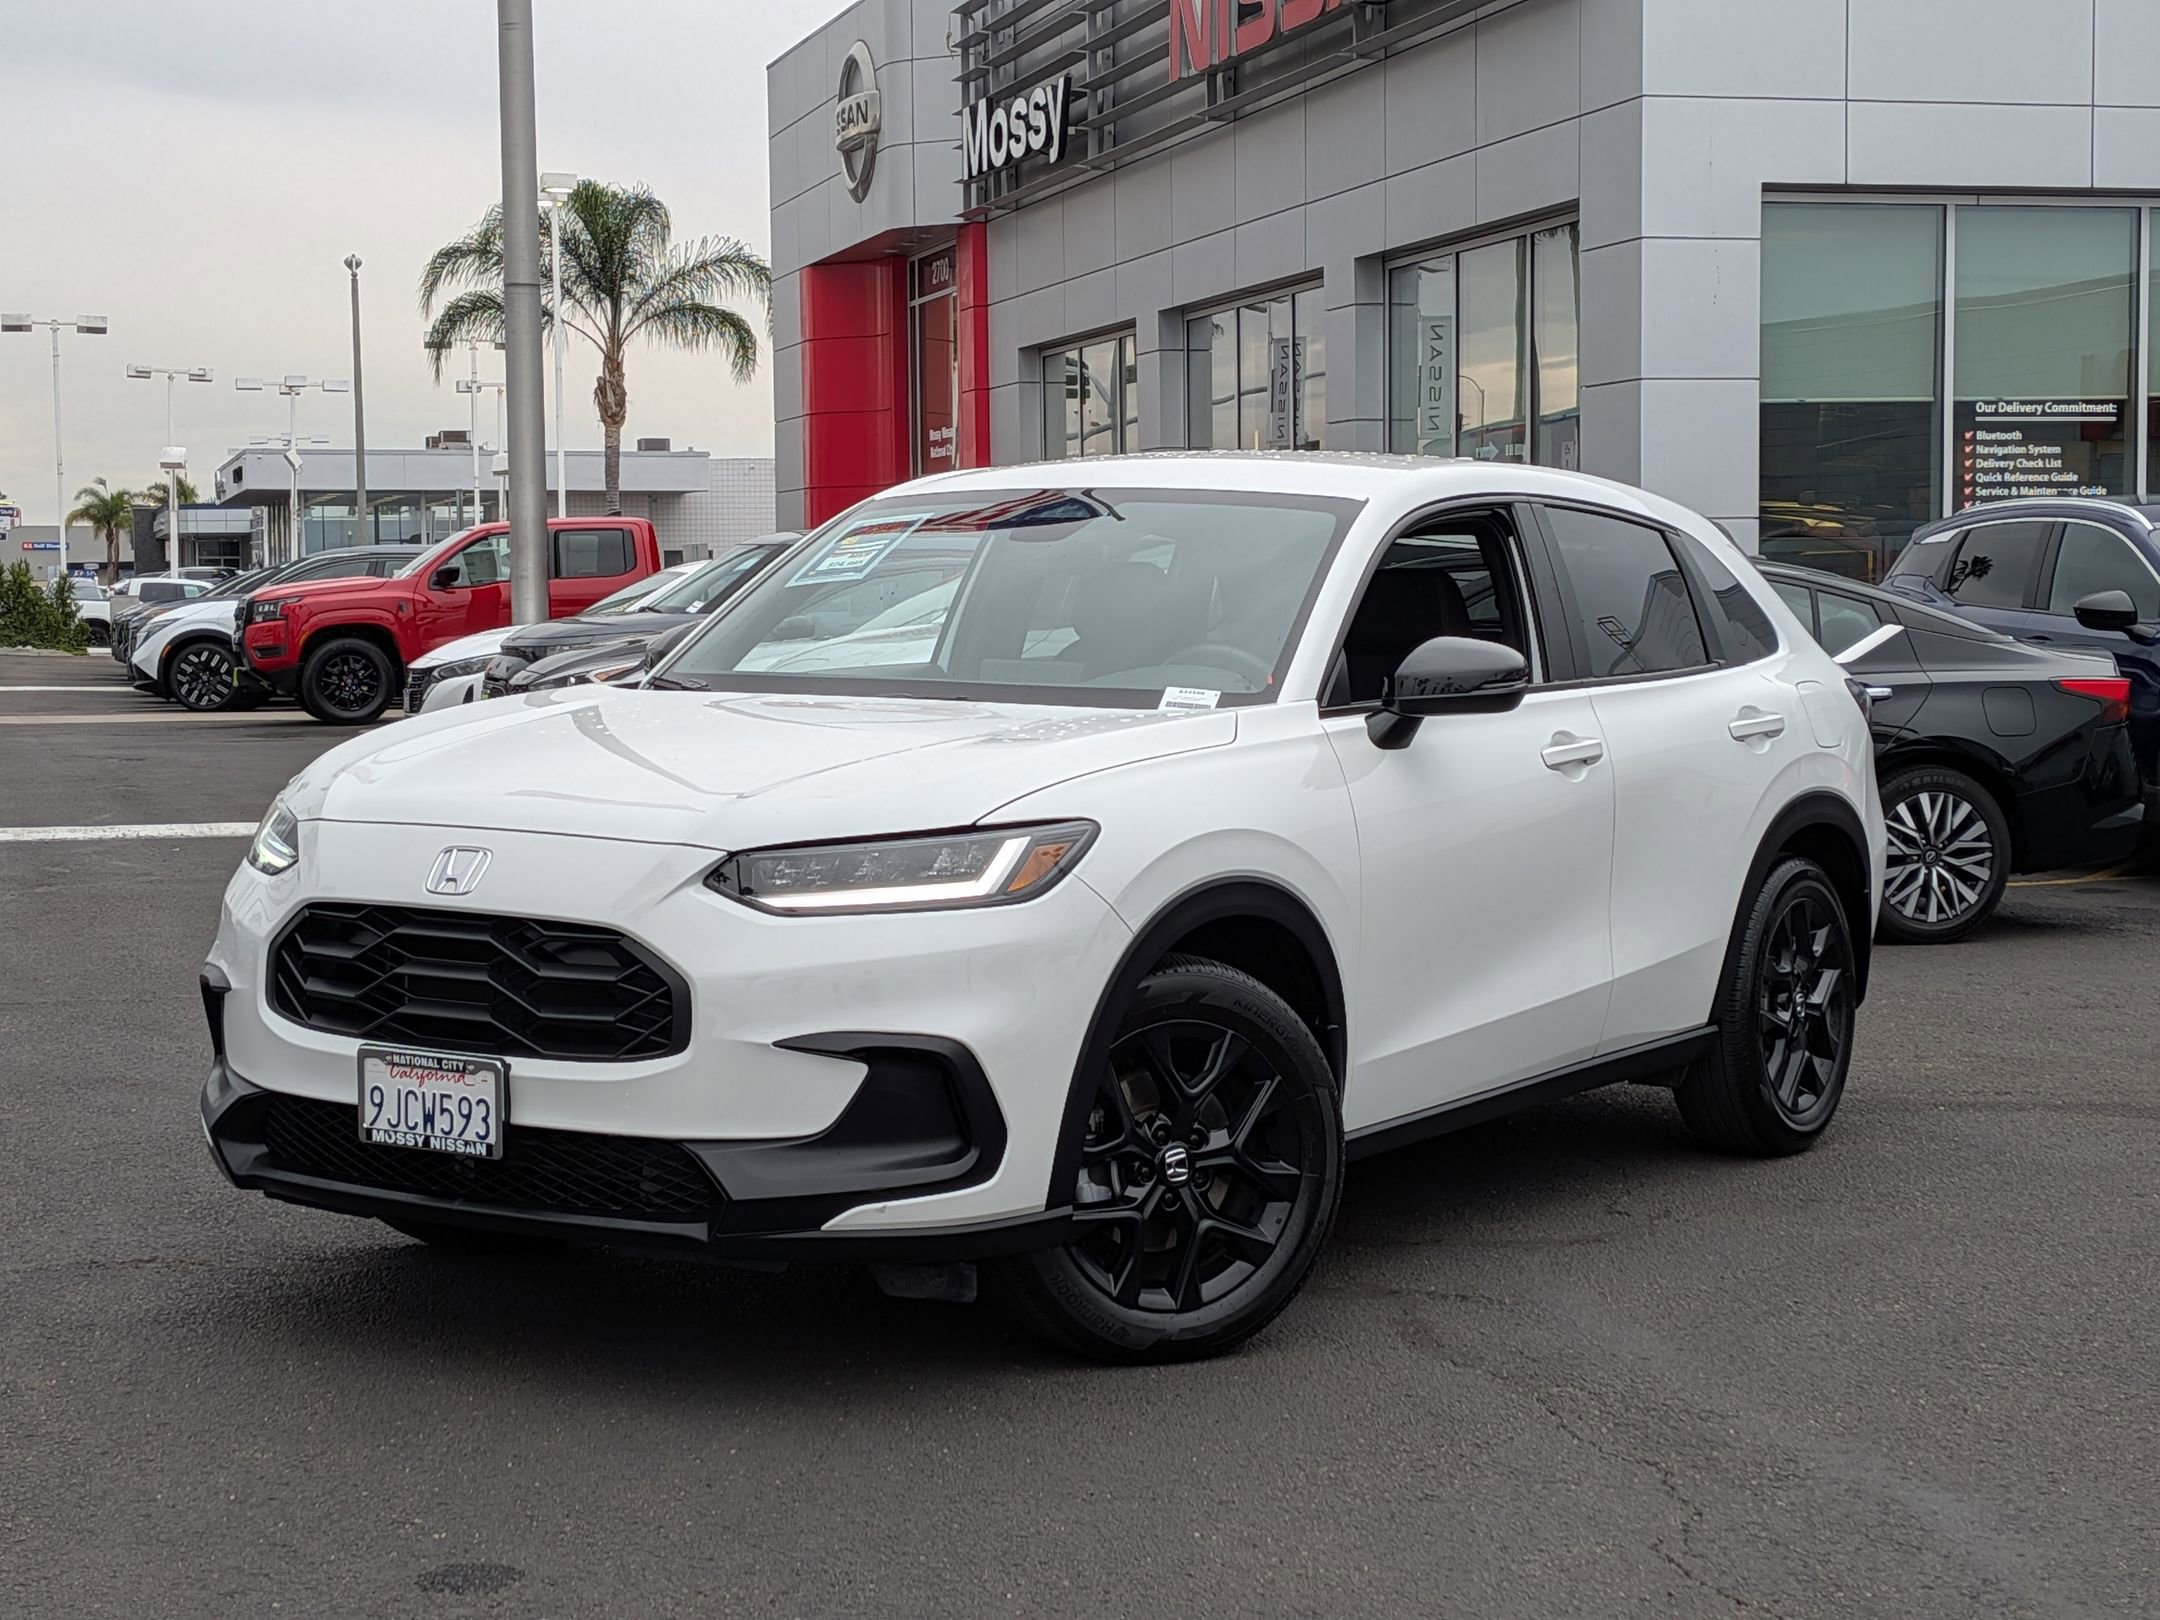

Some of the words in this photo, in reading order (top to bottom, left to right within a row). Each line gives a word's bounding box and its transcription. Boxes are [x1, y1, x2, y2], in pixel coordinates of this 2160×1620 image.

[962, 75, 1067, 180] Mossy
[932, 257, 950, 285] 2700
[1975, 402, 1997, 413] Our
[1998, 402, 2045, 415] Delivery
[2044, 402, 2118, 413] Commitment:
[1976, 430, 2023, 440] Bluetooth
[1976, 445, 2027, 456] Navigation
[2028, 444, 2062, 456] System
[1976, 458, 2015, 470] Delivery
[2016, 458, 2044, 468] Check
[2045, 458, 2063, 468] List
[1975, 472, 2002, 482] Quick
[2003, 472, 2050, 482] Reference
[2051, 472, 2079, 482] Guide
[1975, 486, 2009, 496] Service
[2010, 487, 2018, 496] &
[2019, 486, 2078, 496] Maintence
[2079, 486, 2108, 496] Guide
[393, 1054, 440, 1068] NATIONAL
[441, 1059, 465, 1071] CITY
[390, 1064, 475, 1088] California
[369, 1084, 491, 1141] 9JCW593
[372, 1129, 428, 1148] MOSSY
[430, 1137, 487, 1156] NISSAN
